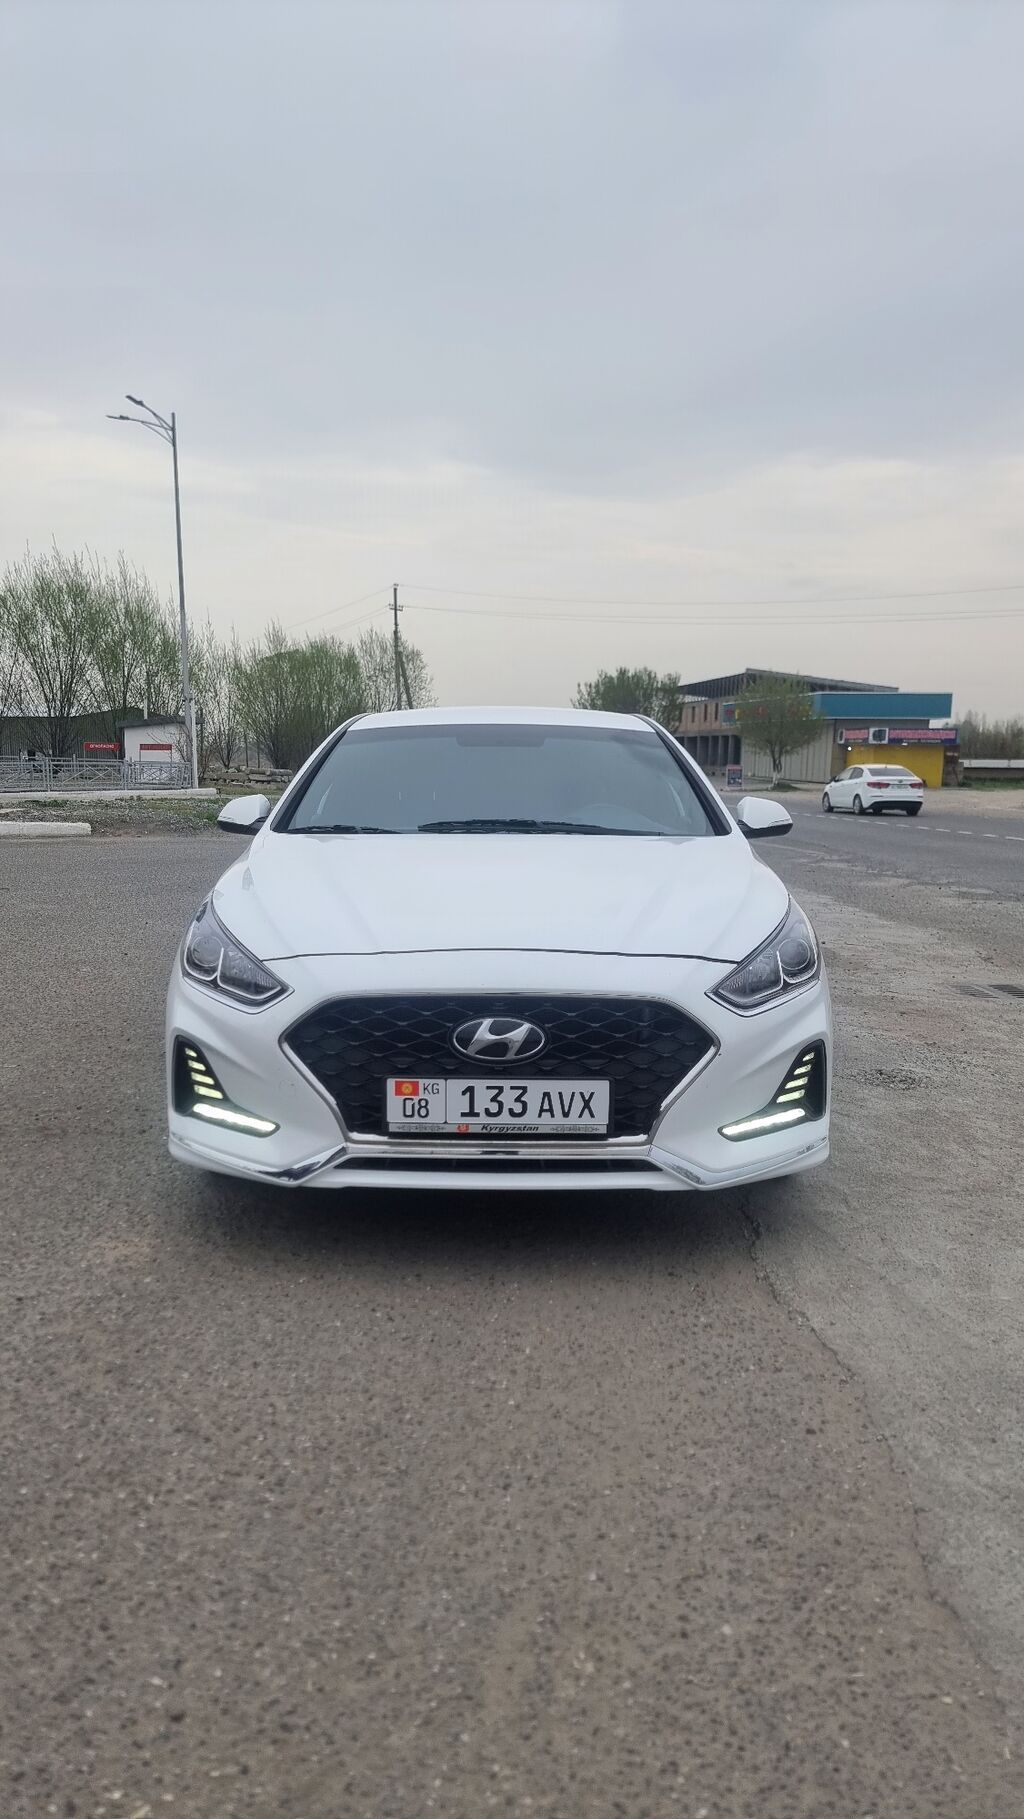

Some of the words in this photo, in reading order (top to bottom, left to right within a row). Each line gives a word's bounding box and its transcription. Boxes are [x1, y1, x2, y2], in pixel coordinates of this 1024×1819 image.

[423, 1083, 440, 1095] KG
[402, 1097, 430, 1118] 08
[460, 1085, 528, 1118] 133
[537, 1091, 596, 1119] AVX
[480, 1124, 540, 1133] Kyrgyzstan
